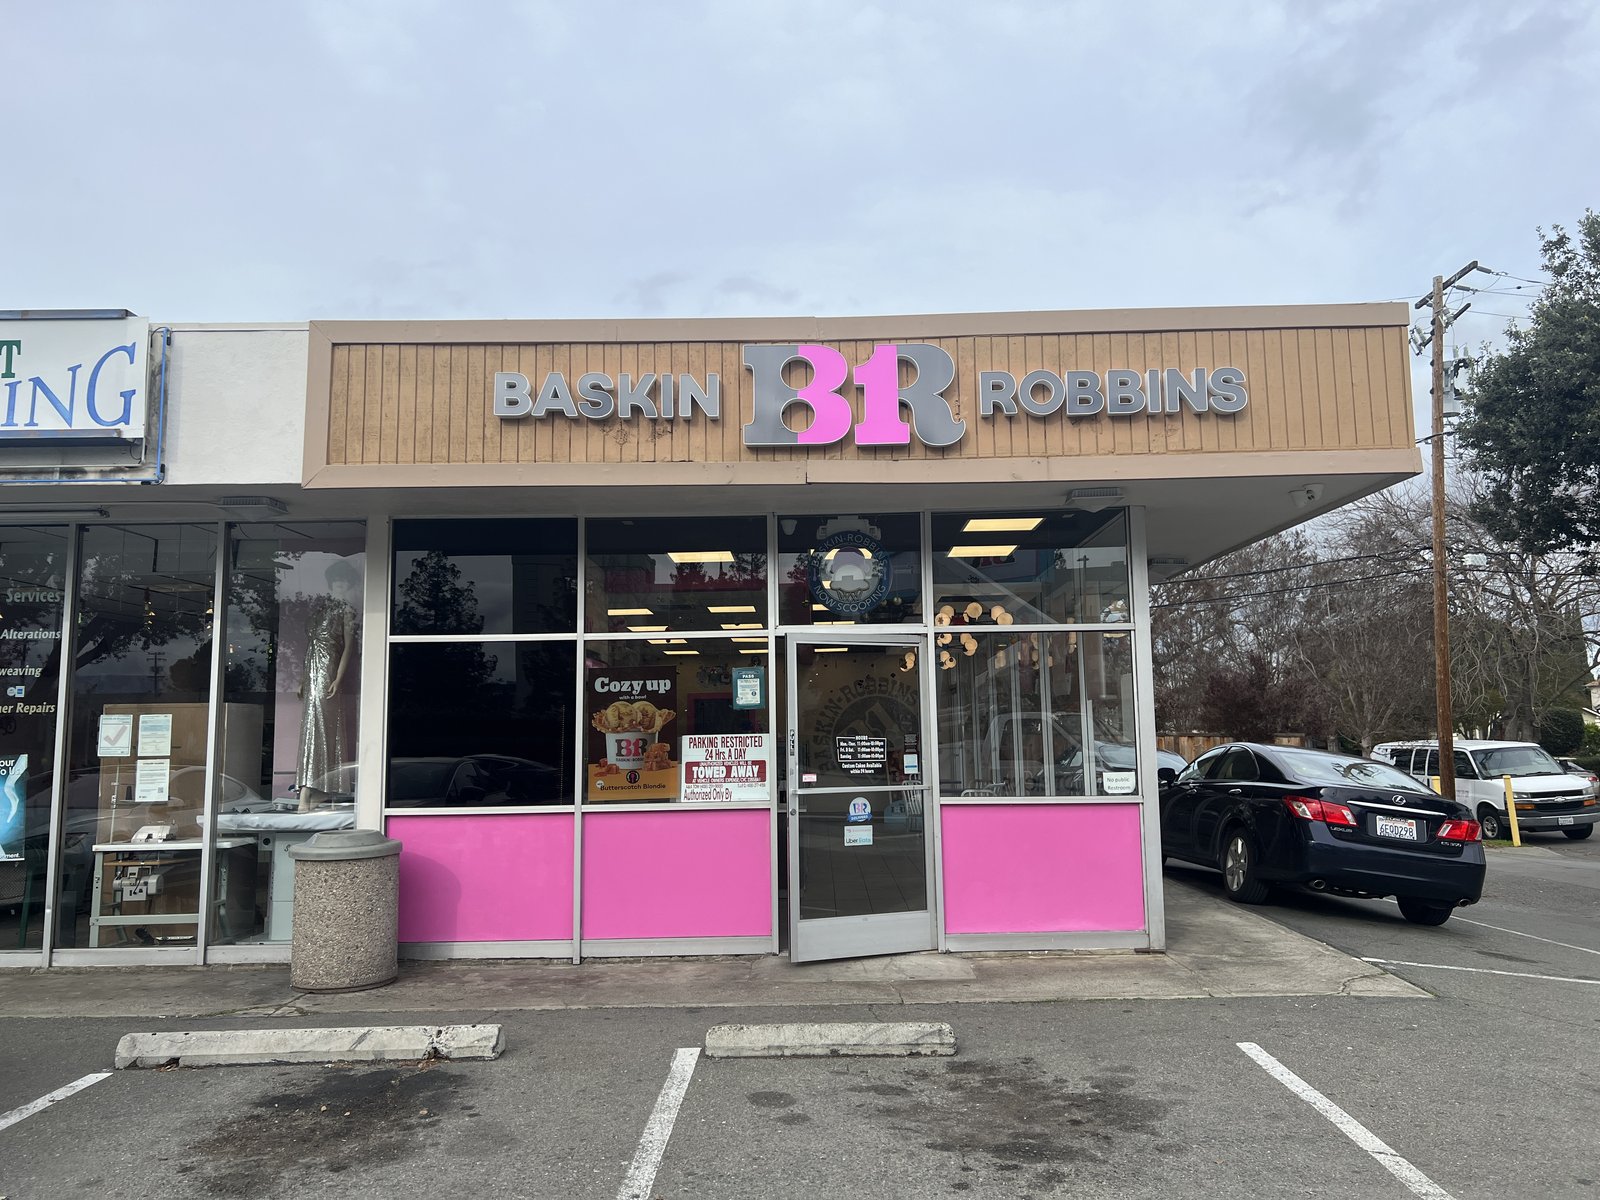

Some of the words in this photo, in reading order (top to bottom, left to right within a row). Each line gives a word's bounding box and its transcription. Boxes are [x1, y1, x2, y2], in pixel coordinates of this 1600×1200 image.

[494, 372, 719, 420] BASKIN
[979, 366, 1247, 416] ROBBINS
[6, 588, 61, 602] Services
[814, 585, 836, 607] NOW
[837, 585, 886, 612] SCOOPING
[0, 628, 61, 639] Alterations
[594, 677, 643, 694] Cozy
[646, 679, 671, 693] up
[16, 702, 55, 715] Repairs
[689, 736, 718, 749] PARKING
[721, 736, 762, 748] RESTRICTED
[705, 749, 713, 760] 24
[728, 748, 732, 759] A
[734, 748, 746, 759] DAY
[692, 766, 726, 778] TOWED
[731, 765, 759, 778] AWAY
[684, 789, 711, 800] Authorized
[713, 788, 724, 802] Only
[725, 788, 732, 801] By
